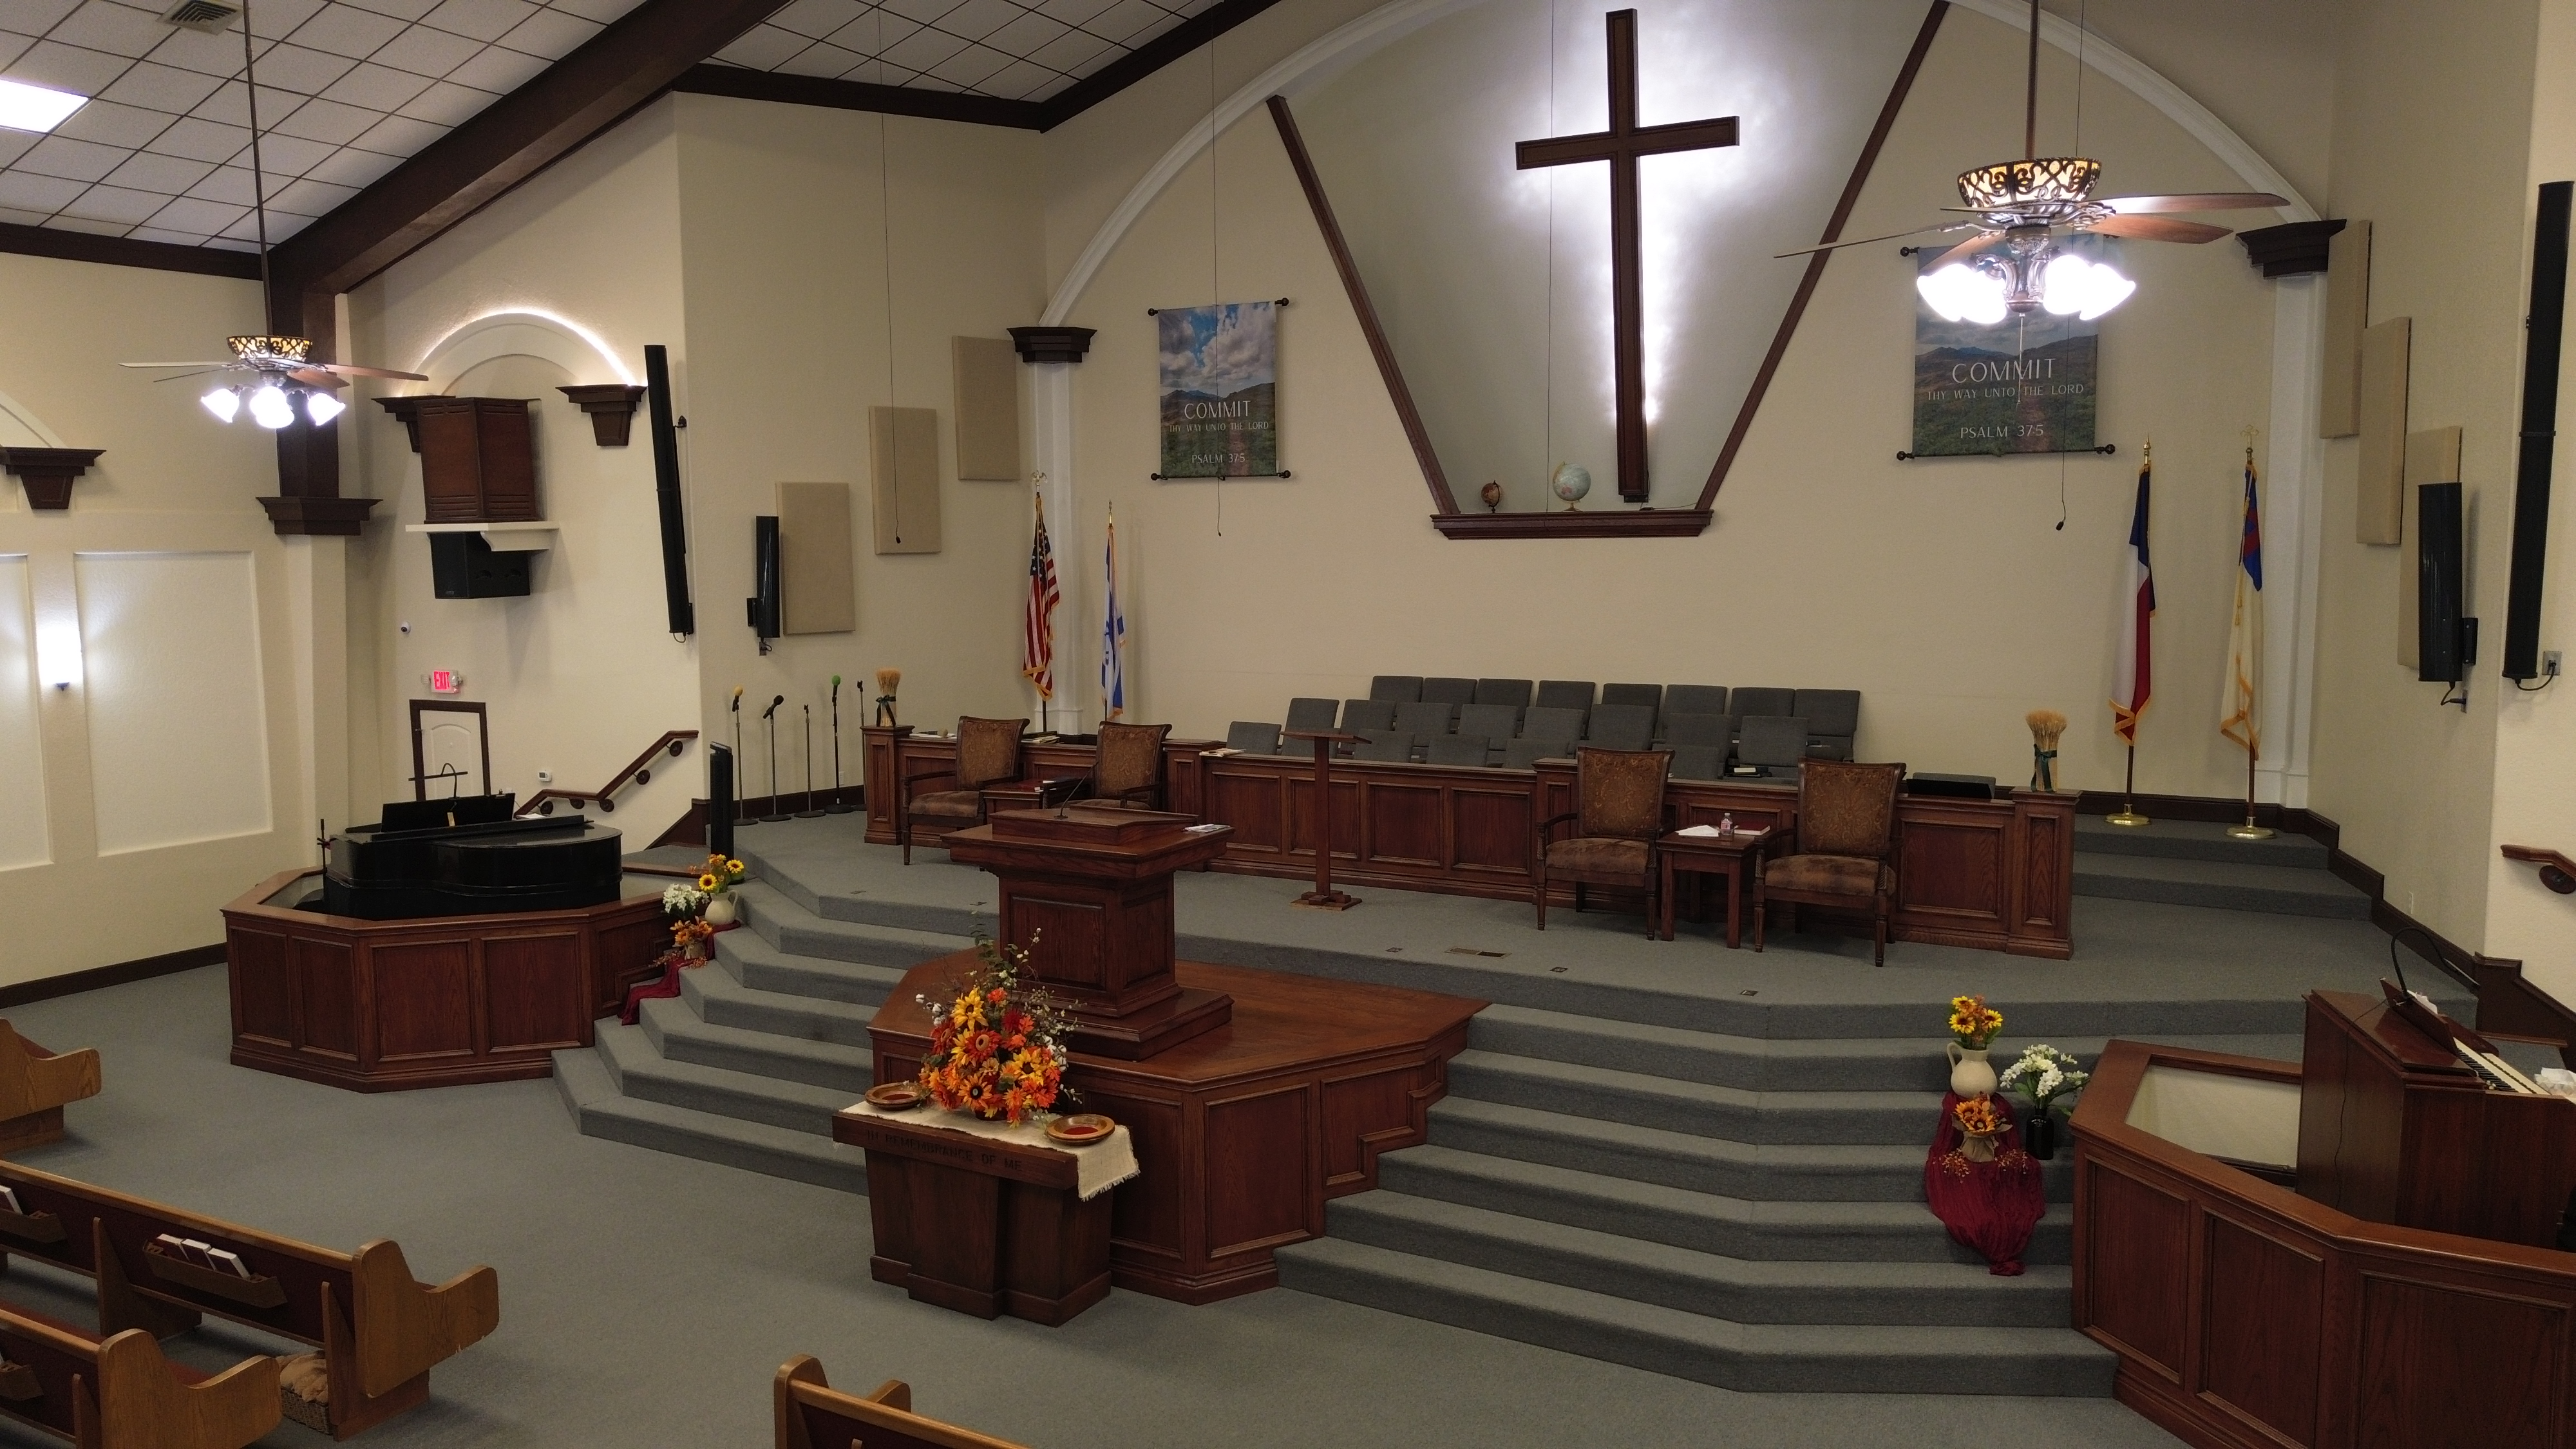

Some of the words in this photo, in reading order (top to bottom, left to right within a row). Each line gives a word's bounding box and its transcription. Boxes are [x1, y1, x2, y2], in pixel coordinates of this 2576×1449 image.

[1951, 358, 2056, 384] COMMIT
[1927, 390, 1946, 401] THY
[1954, 389, 1977, 399] WAY
[1984, 387, 2016, 399] UNTO
[2023, 386, 2043, 396] THE
[2051, 384, 2084, 395] LORD
[1184, 400, 1251, 419] COMMIT
[1169, 424, 1181, 433] THY
[1186, 423, 1202, 432] WAY
[1205, 422, 1226, 431] UNTO
[1230, 421, 1244, 431] THE
[1248, 421, 1269, 430] LORD
[1960, 425, 2009, 439] PSALM
[1191, 453, 1223, 464] PSALM
[433, 670, 451, 690] EXIT
[981, 1153, 997, 1166] OF
[1004, 1157, 1023, 1172] ME
